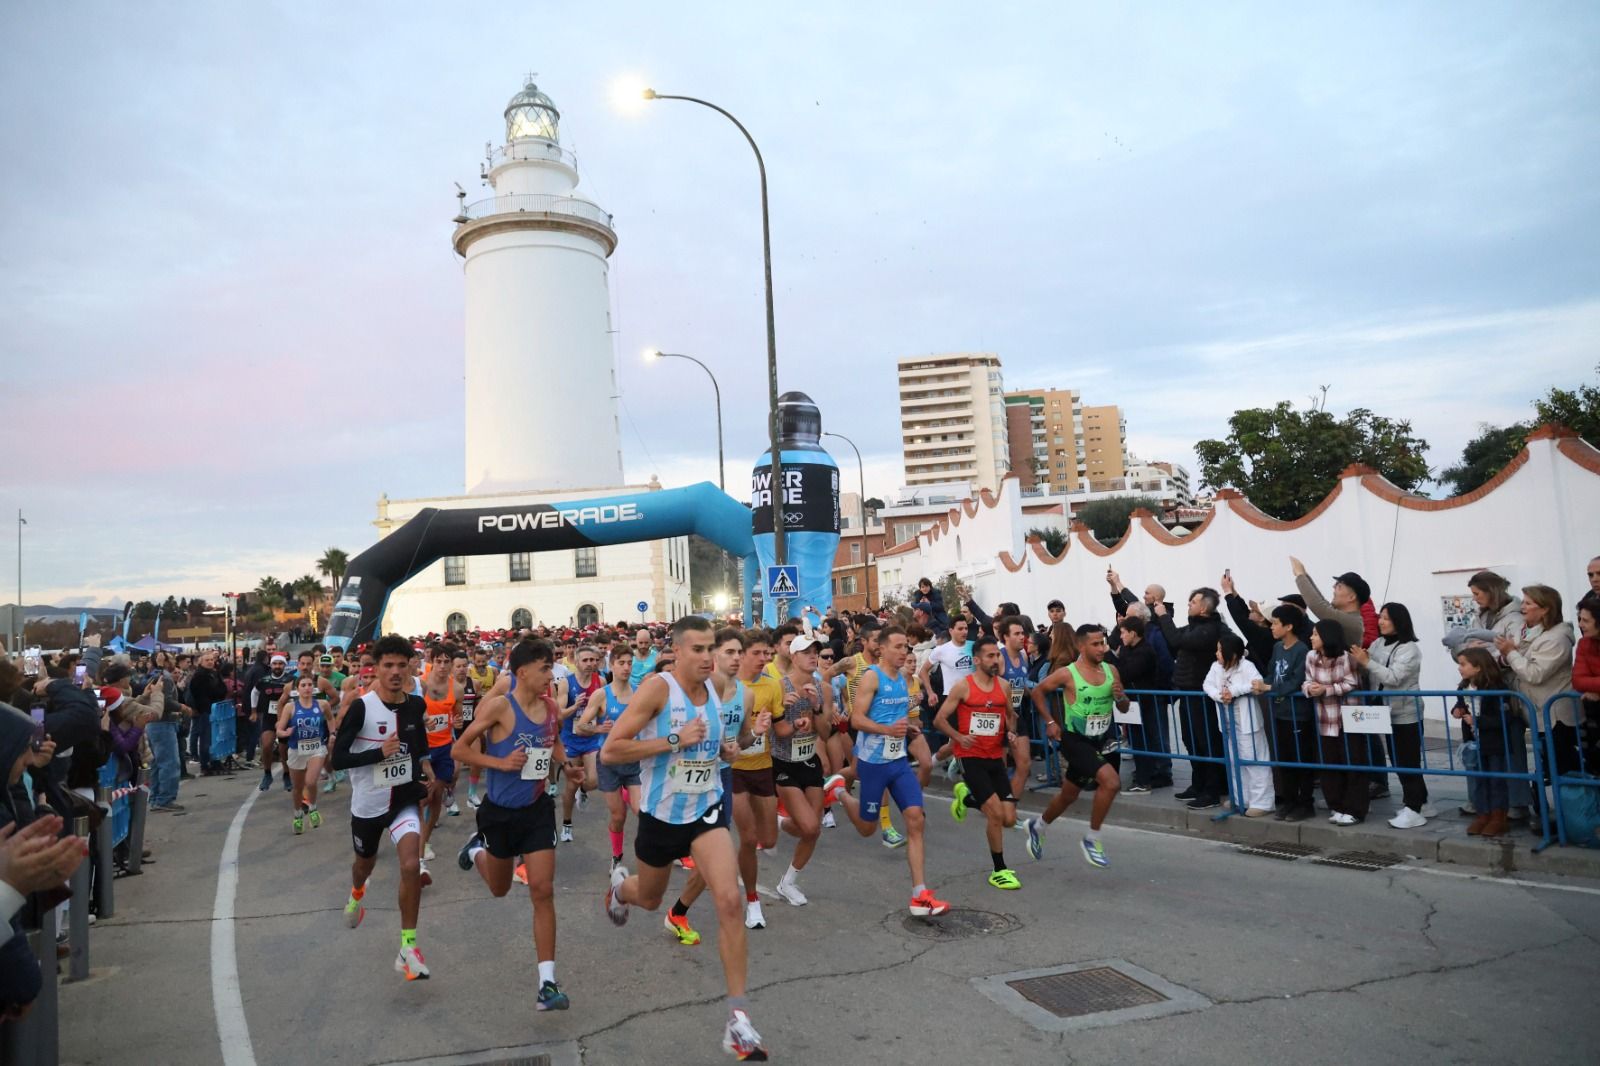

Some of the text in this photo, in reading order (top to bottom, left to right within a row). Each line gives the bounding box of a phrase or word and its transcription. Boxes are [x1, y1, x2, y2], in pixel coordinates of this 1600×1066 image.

[478, 503, 637, 533] POWERADE
[297, 716, 320, 728] RCM
[976, 719, 995, 729] 306
[798, 743, 814, 757] 1417
[382, 764, 406, 779] 106
[685, 768, 711, 783] 170
